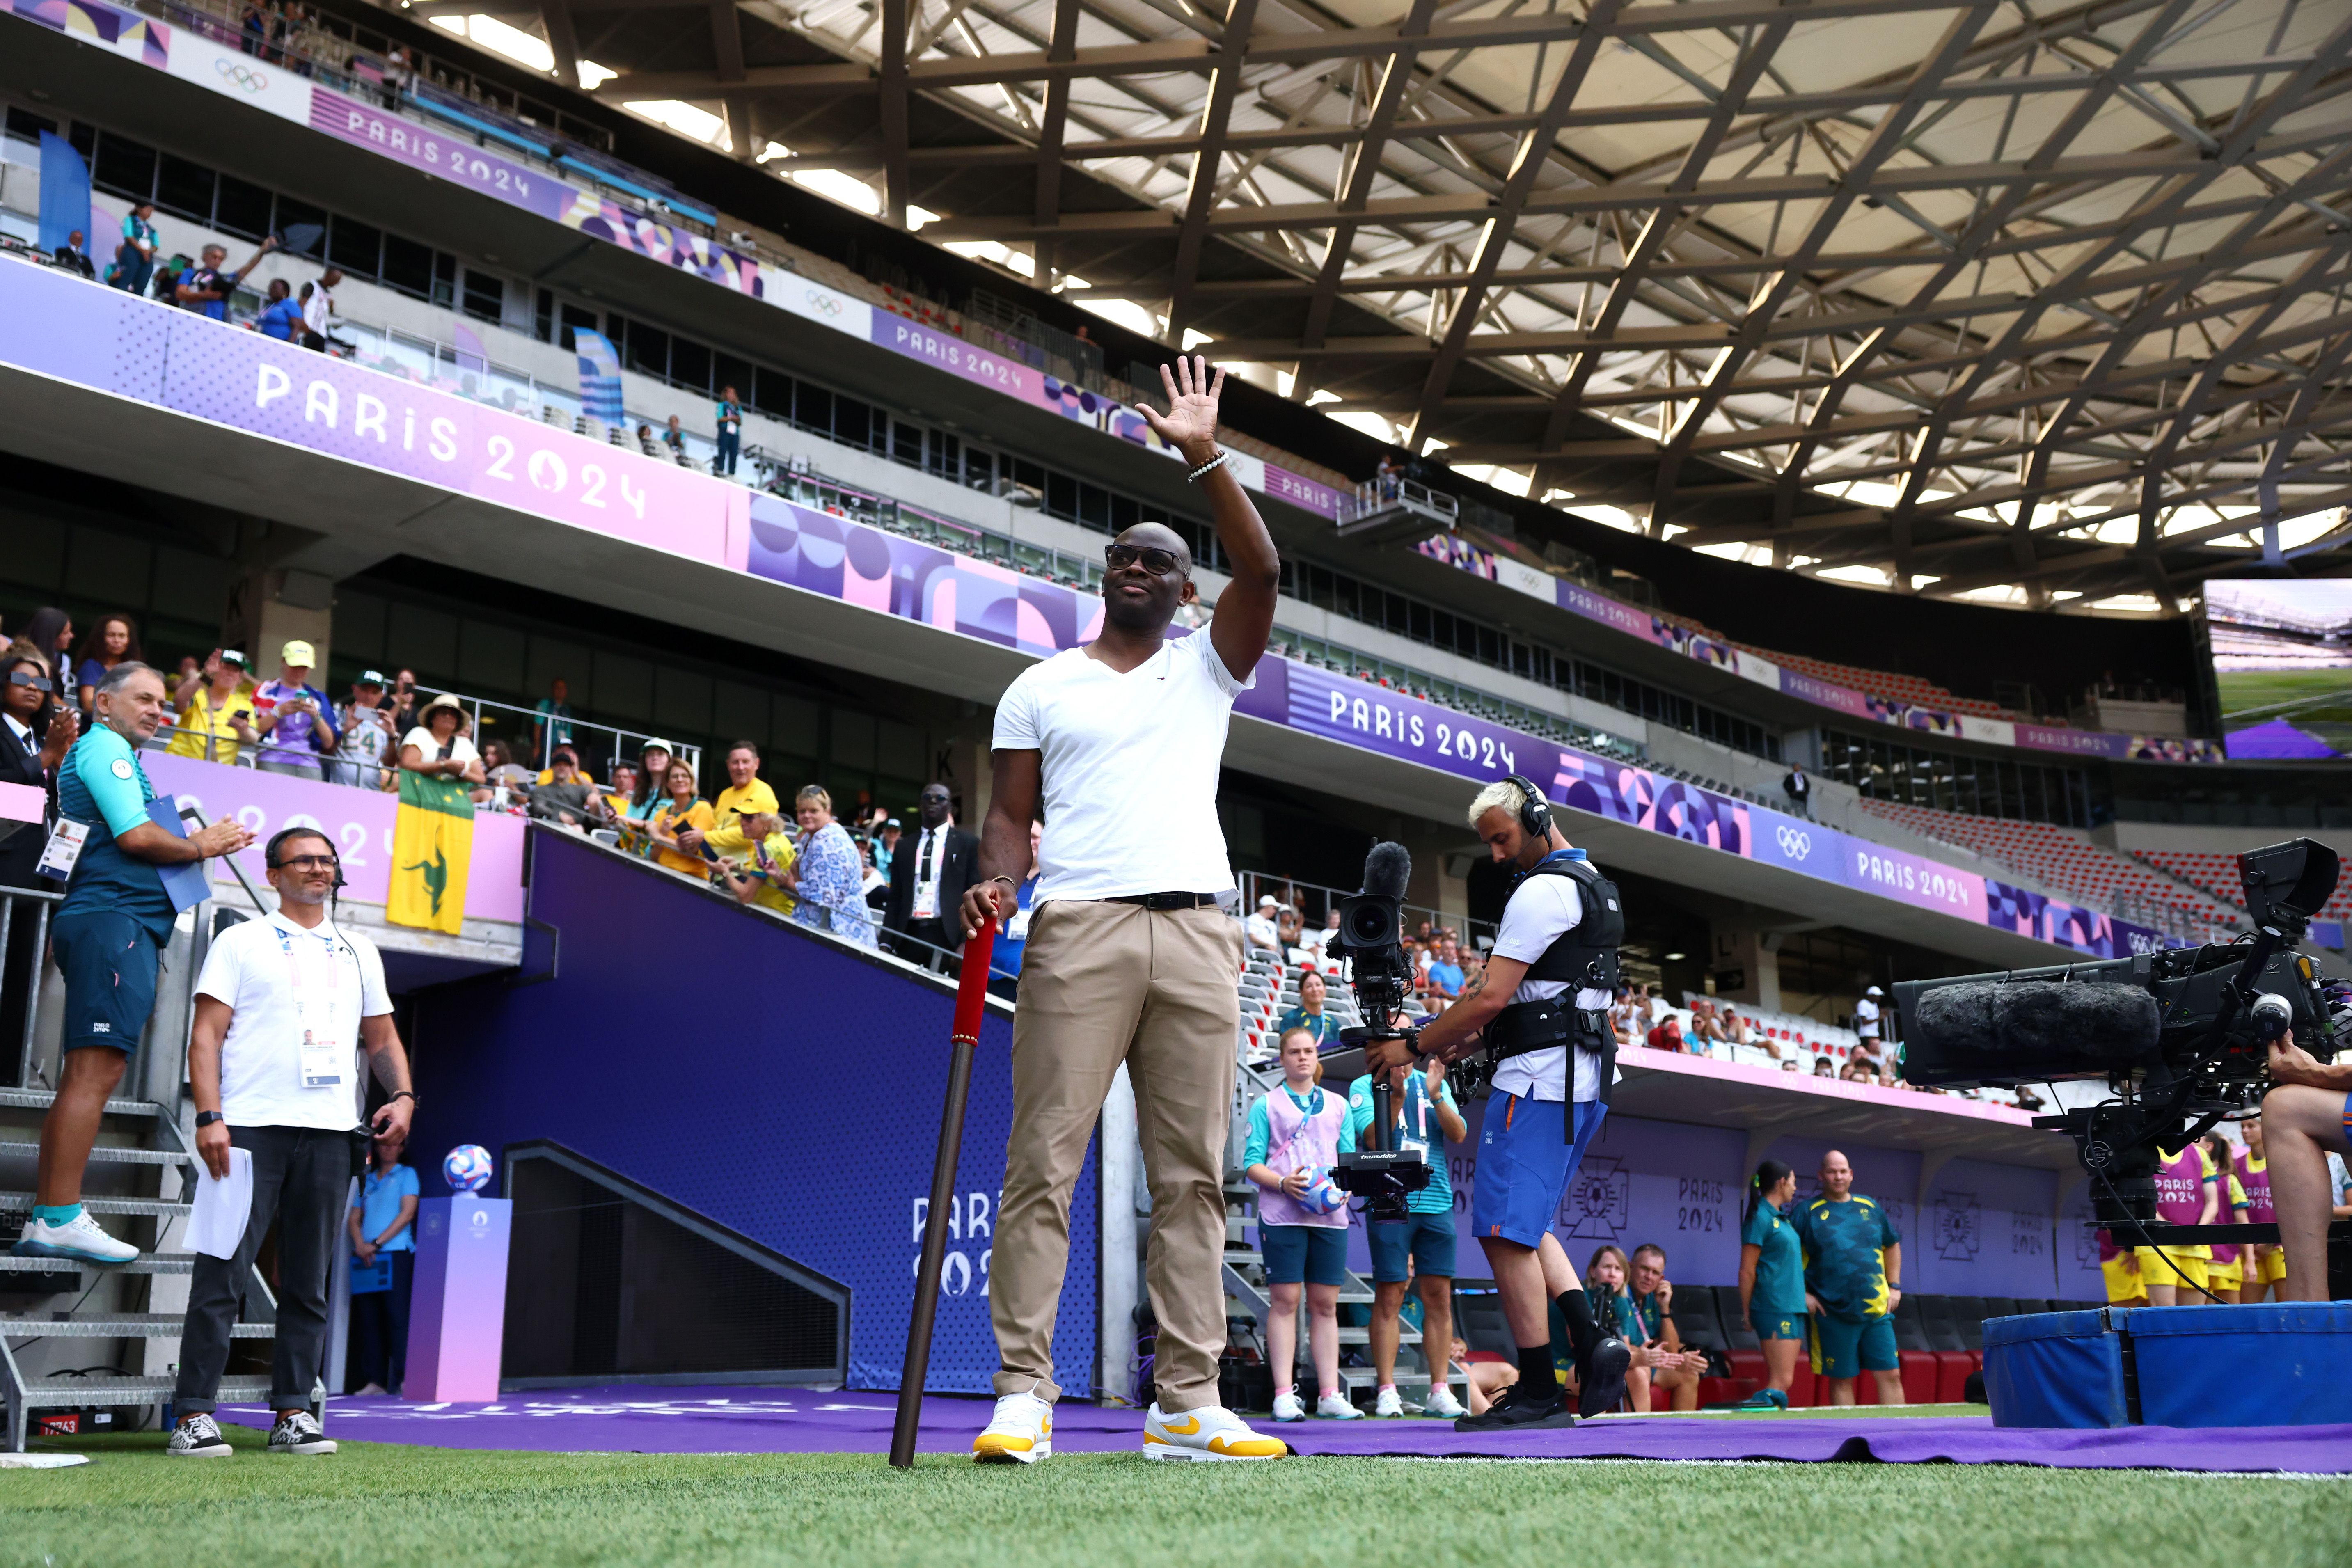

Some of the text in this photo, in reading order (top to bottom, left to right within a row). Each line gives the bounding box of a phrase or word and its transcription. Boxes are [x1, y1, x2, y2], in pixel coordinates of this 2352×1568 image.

[451, 151, 529, 198] 2024
[966, 354, 1021, 389] 2024
[256, 362, 645, 520] PARiS 2024
[1608, 606, 1640, 629] 2024
[1824, 689, 1855, 707] 2024
[1331, 691, 1515, 774] PARiS 2024
[2073, 737, 2110, 751] 2024
[1920, 871, 1968, 906] 2024
[1509, 937, 1520, 945] OBS
[1842, 1083, 1866, 1097] 2024
[1679, 1177, 1724, 1204] PARiS
[2158, 1192, 2195, 1203] 2024
[2246, 1187, 2271, 1197] ARiS
[2249, 1199, 2273, 1209] 024
[1678, 1207, 1724, 1232] 2024
[2013, 1235, 2043, 1254] 2024
